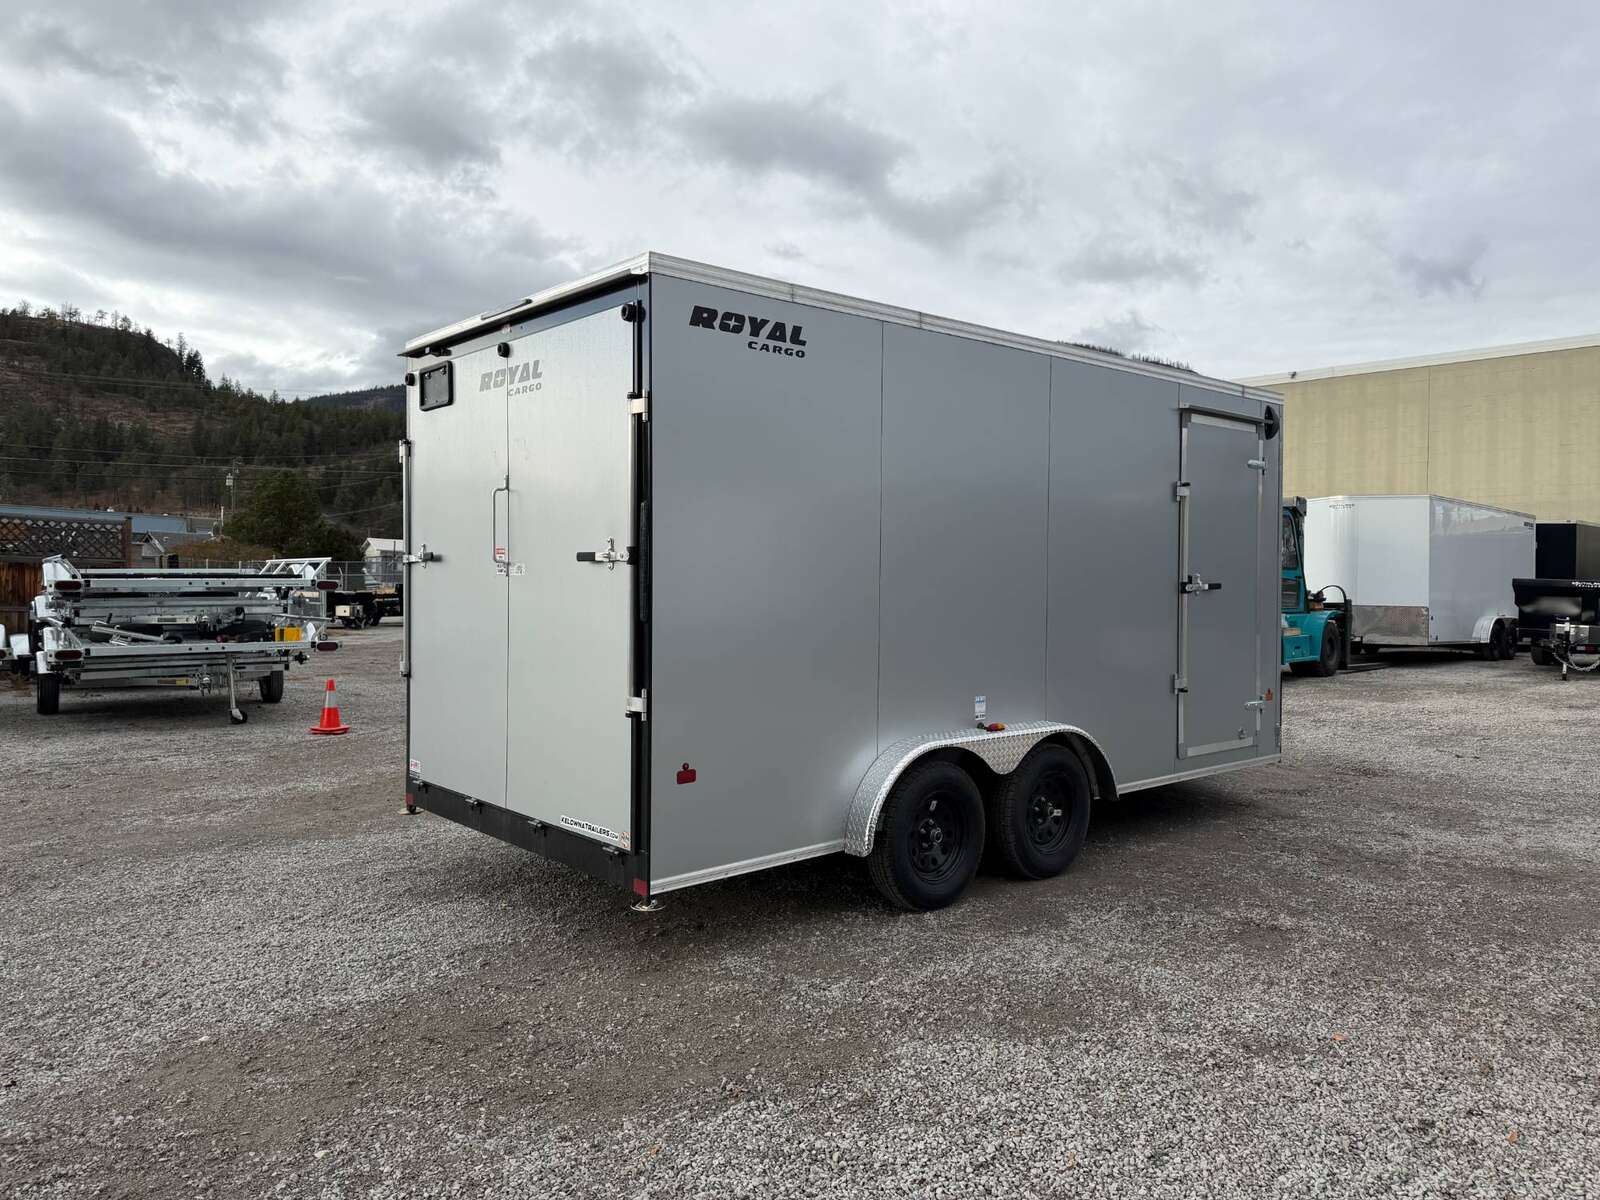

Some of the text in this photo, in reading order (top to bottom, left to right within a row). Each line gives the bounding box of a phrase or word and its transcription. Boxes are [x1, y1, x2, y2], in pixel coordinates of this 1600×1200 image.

[689, 305, 807, 346] ROYAL
[747, 341, 806, 358] CARGO
[479, 360, 543, 392] ROYAL
[508, 382, 542, 397] CARGO
